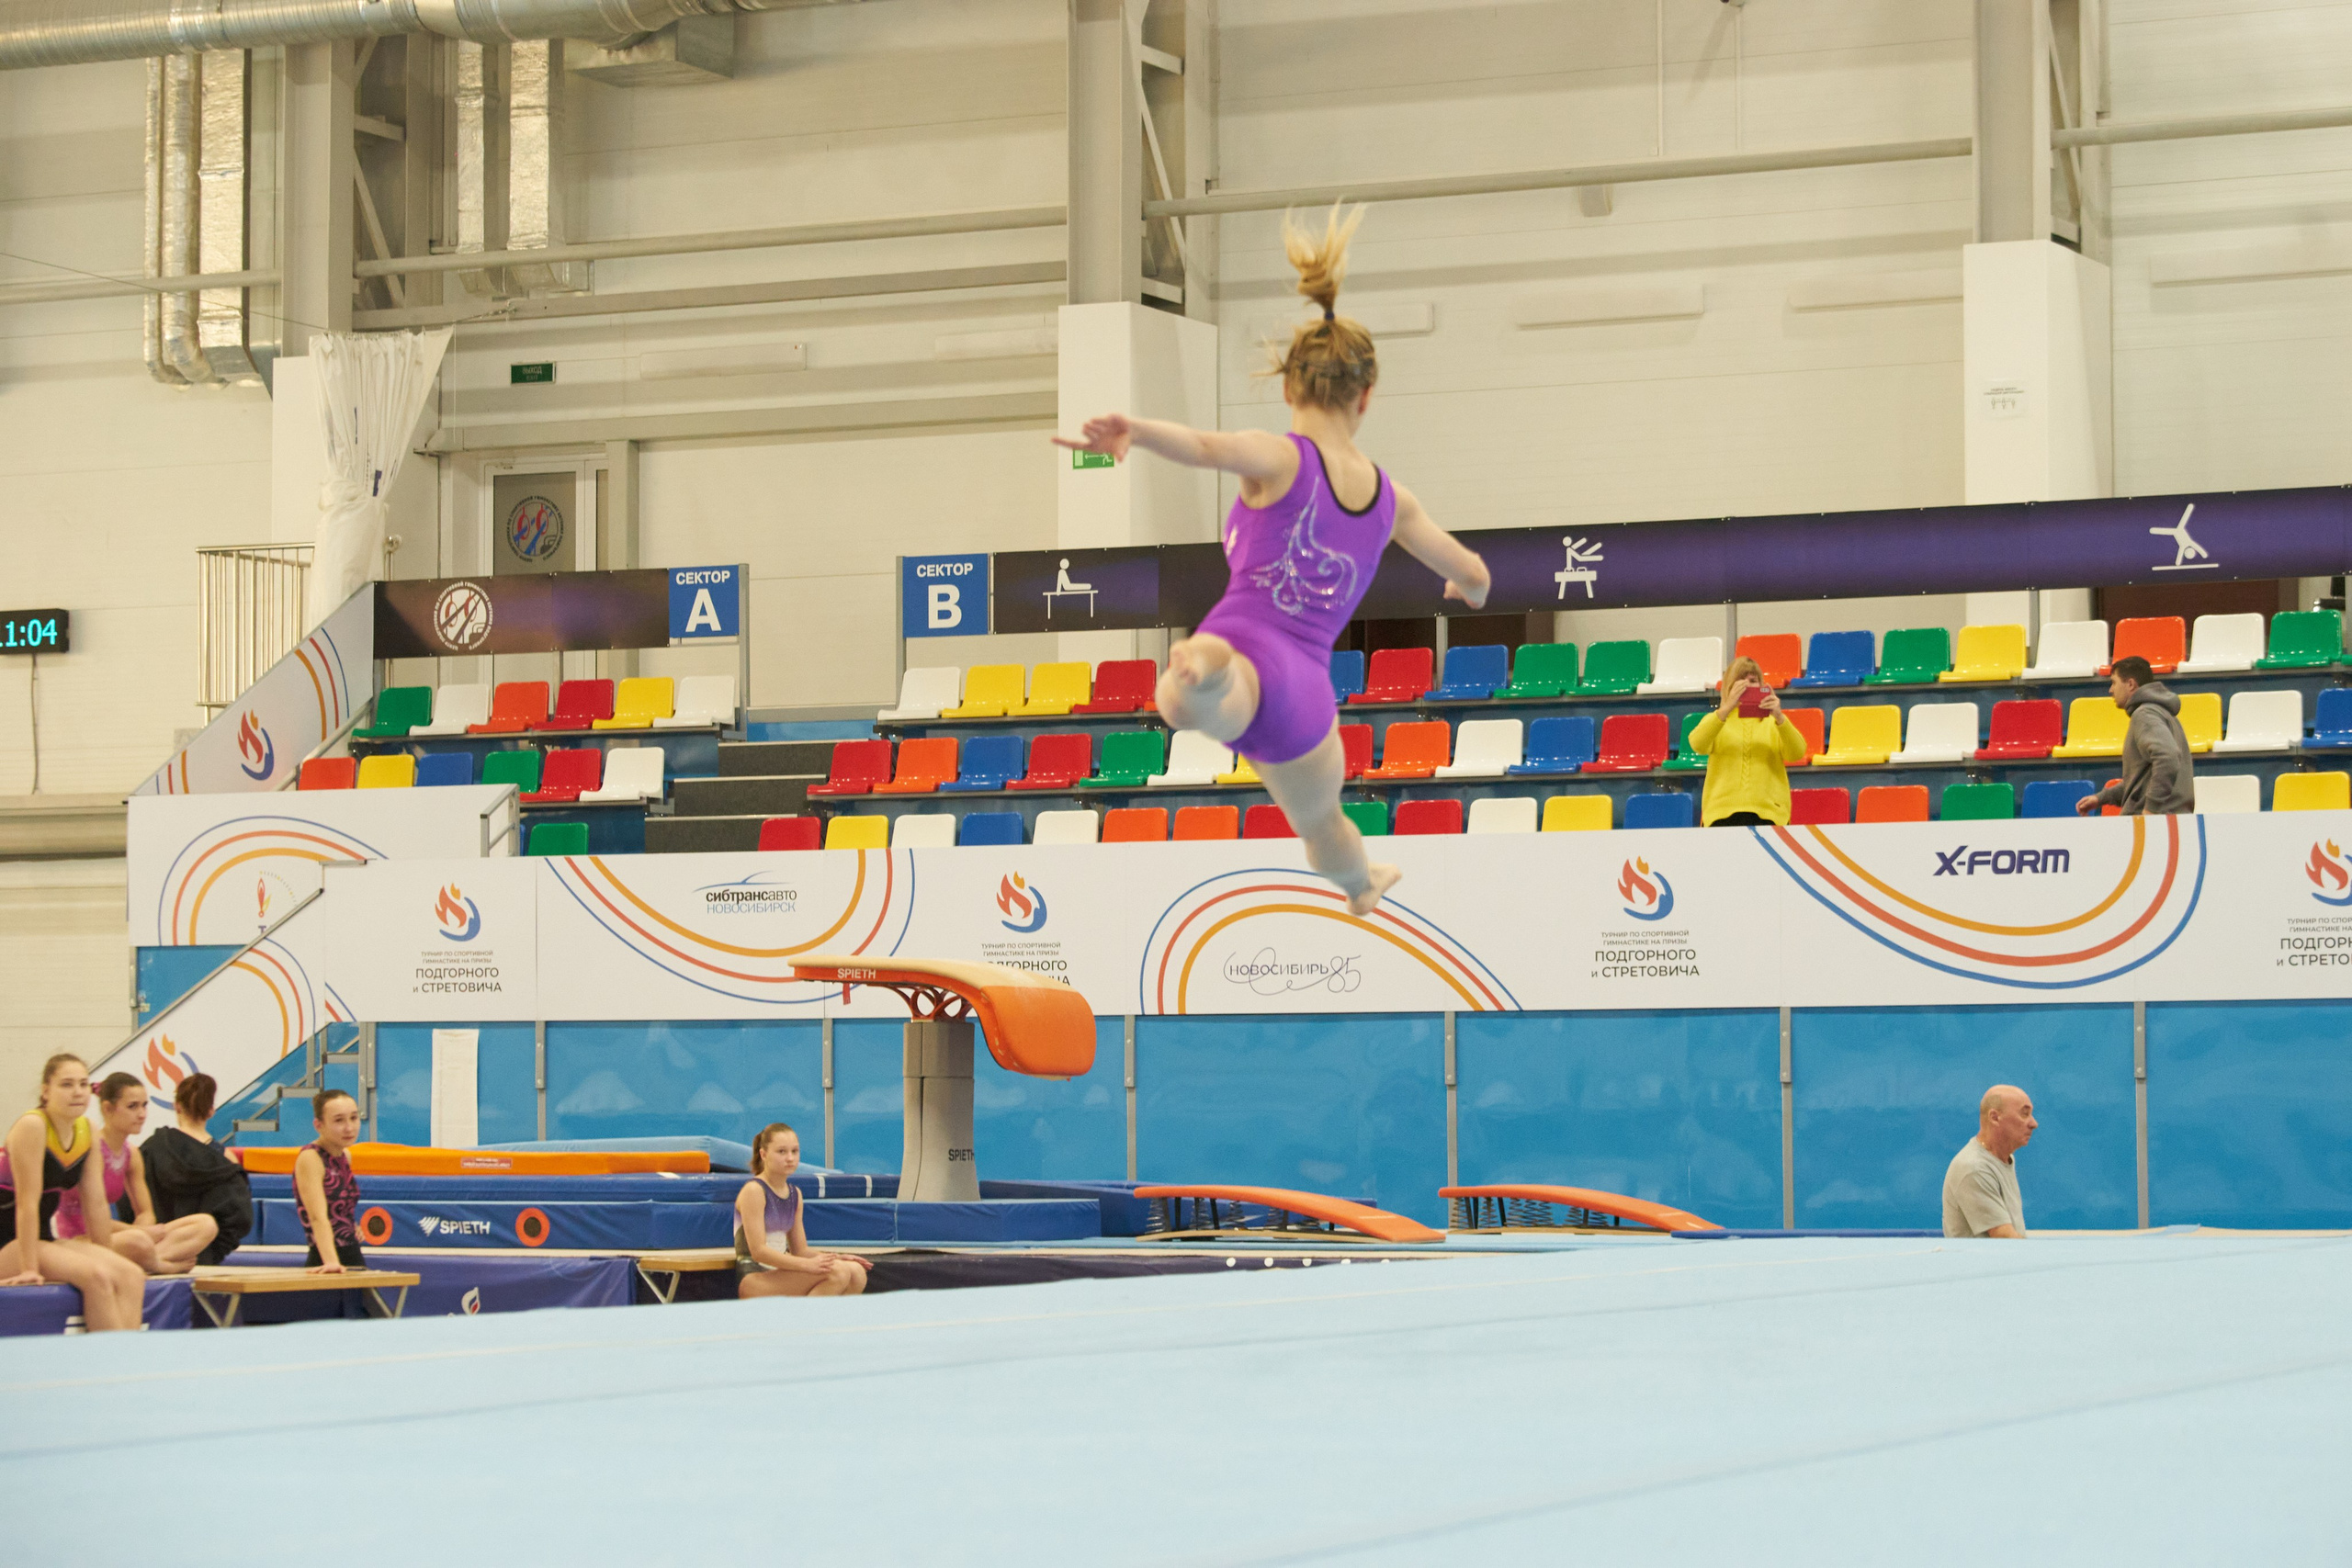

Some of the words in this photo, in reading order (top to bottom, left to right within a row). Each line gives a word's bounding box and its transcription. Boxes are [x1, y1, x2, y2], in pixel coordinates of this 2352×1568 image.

[916, 562, 974, 578] СЕКТОР
[675, 570, 730, 585] СЕКТОР
[0, 618, 58, 648] 1:04
[1932, 845, 2070, 876] X-FORM
[706, 888, 797, 904] сибтрансавто
[707, 901, 797, 914] НОВОСИБИРСК
[1641, 929, 1690, 937] СПОРТИВНОЙ
[1595, 949, 1696, 963] ПОДГОРНОГО
[2288, 953, 2352, 966] СТРЕТО
[415, 967, 499, 980] ПОДГОРНОГО
[837, 967, 876, 979] SPIETH
[1601, 964, 1700, 978] СТРЕТОВИЧА
[422, 982, 502, 993] СТРЕТОВИЧА
[439, 1220, 491, 1235] SPIETH
